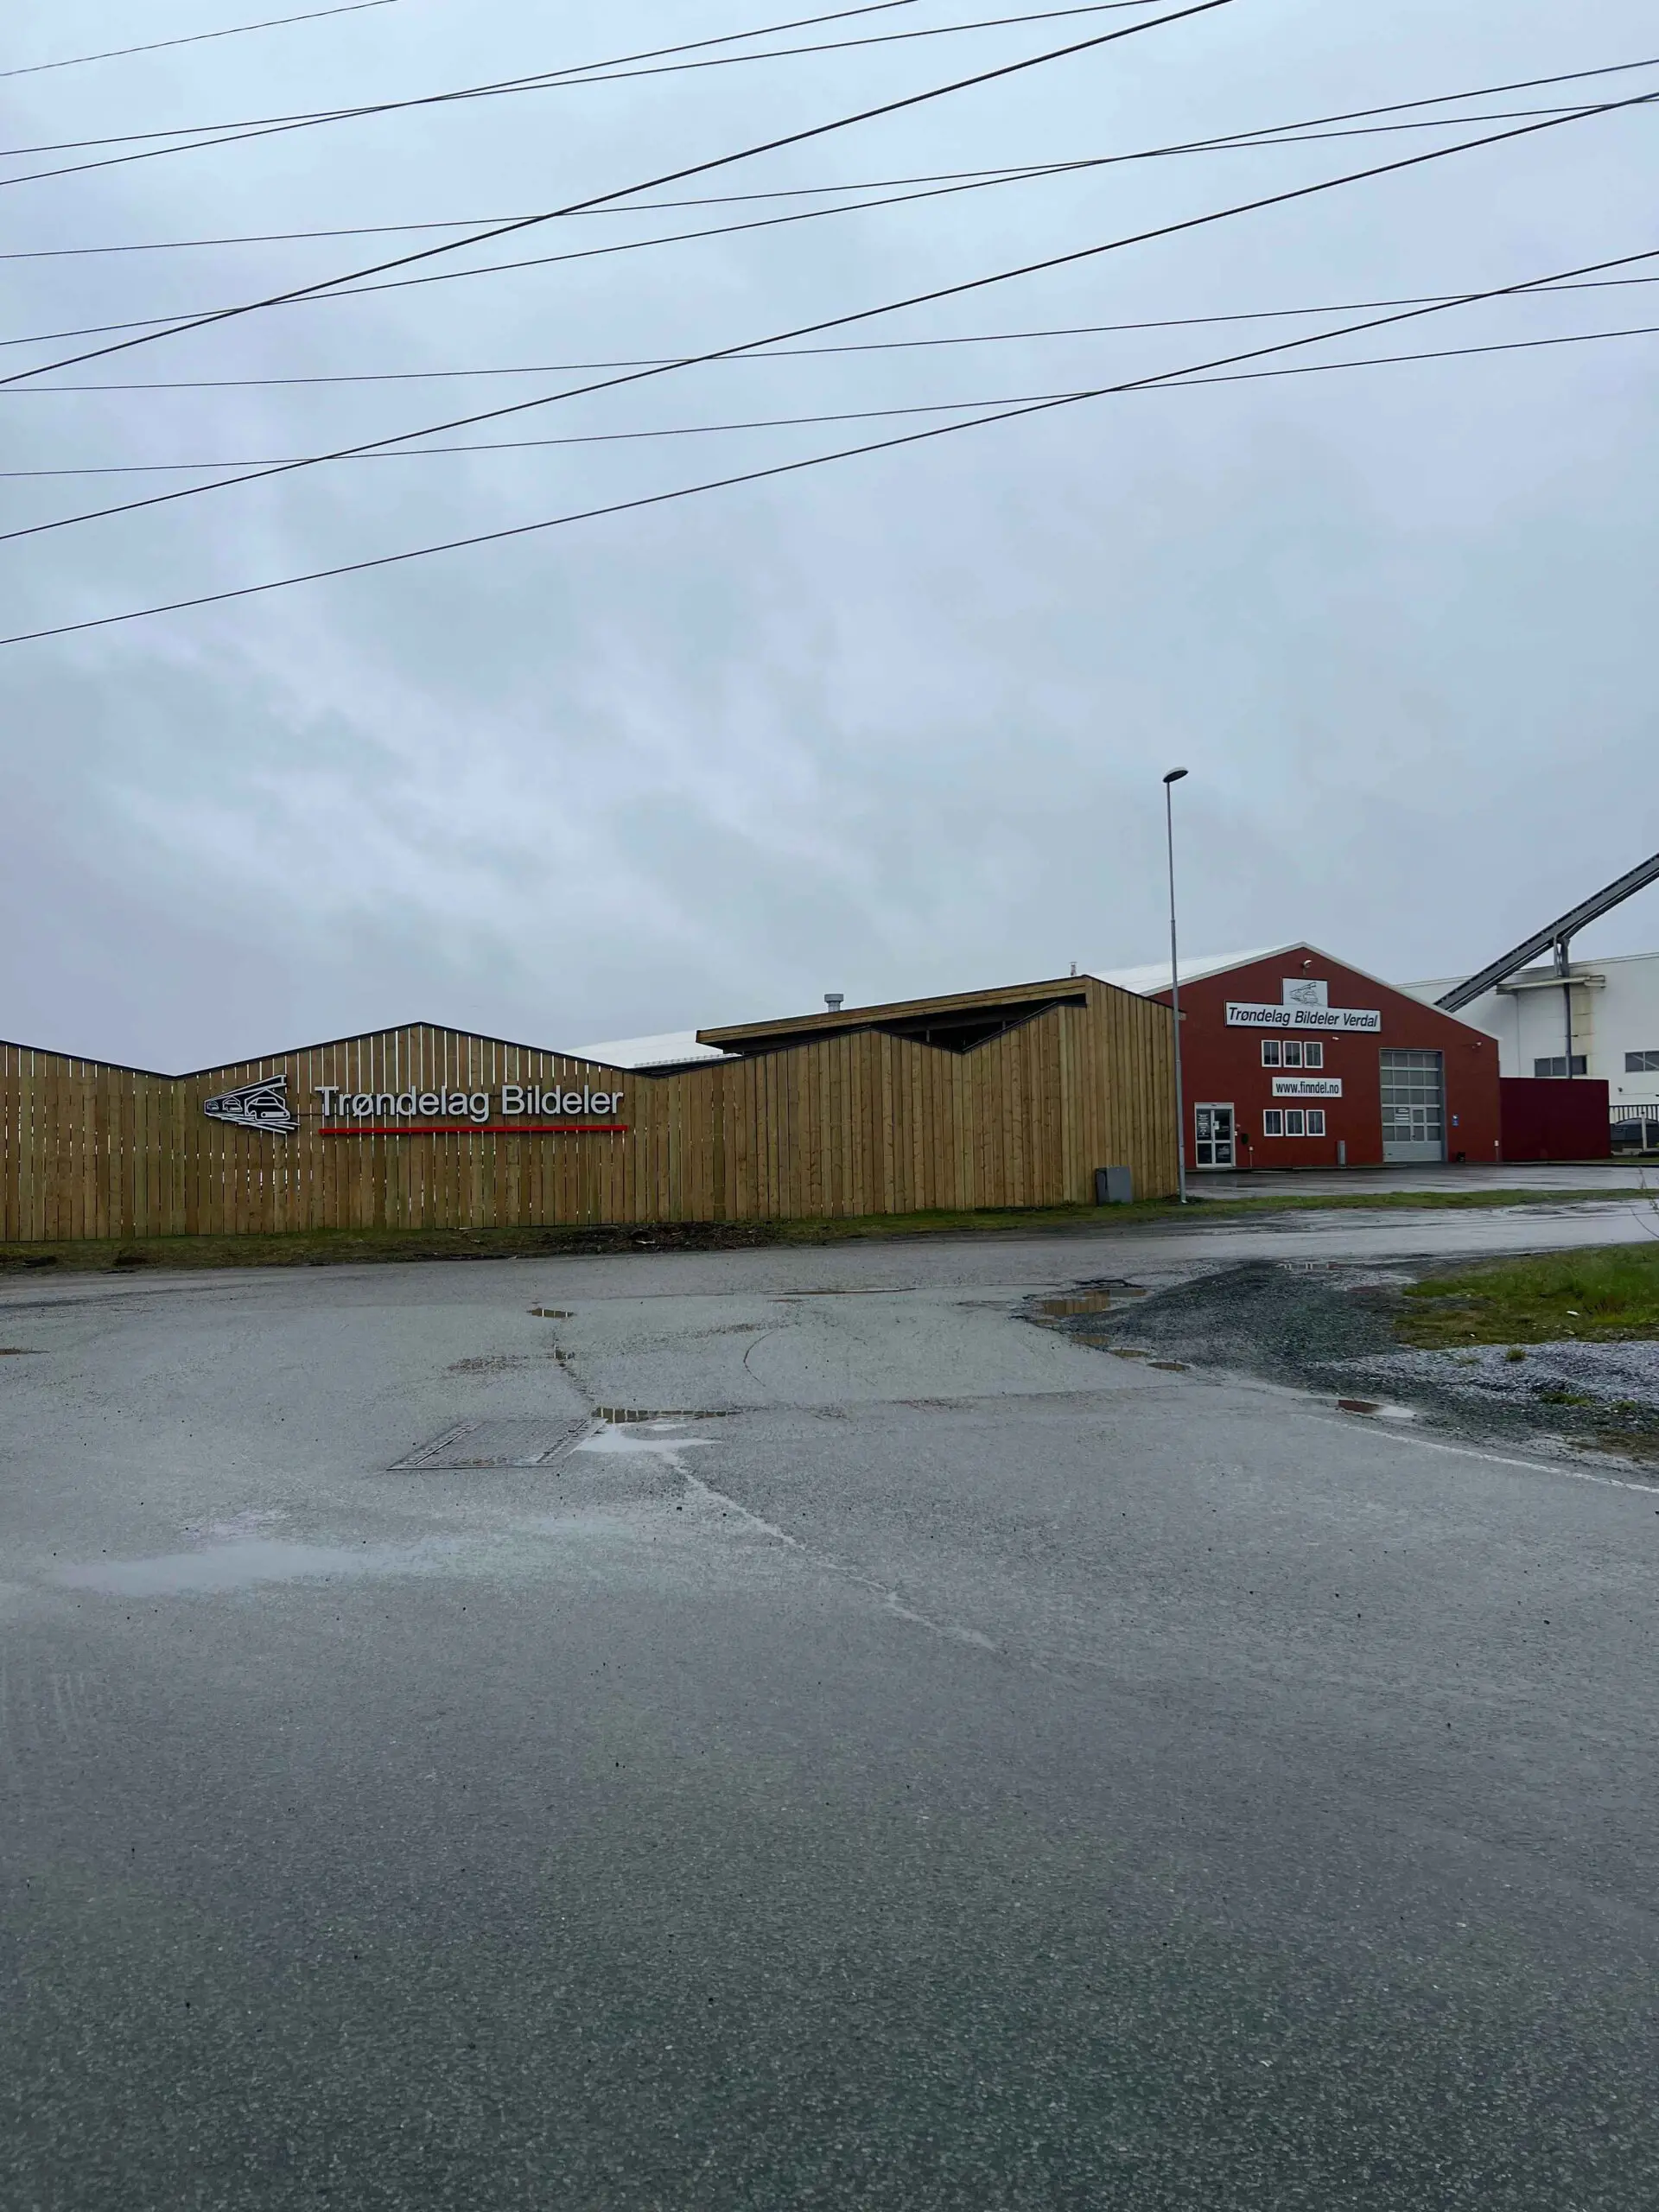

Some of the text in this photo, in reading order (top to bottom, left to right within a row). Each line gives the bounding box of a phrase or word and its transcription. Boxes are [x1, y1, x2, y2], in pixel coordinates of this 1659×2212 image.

[1229, 1007, 1377, 1027] Trøndelag Bildeler Verdal
[1276, 1081, 1338, 1094] www.finndel.no
[315, 1085, 623, 1122] Trøndelag Bildeler
